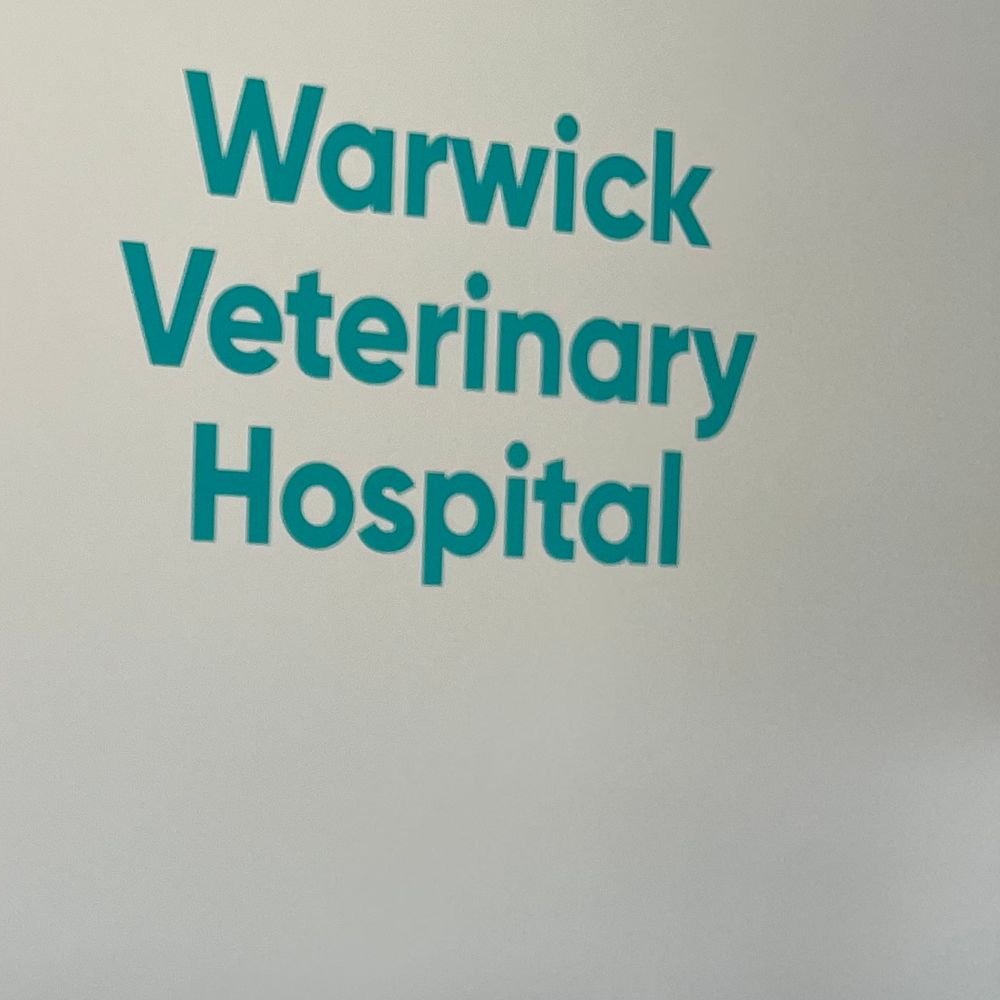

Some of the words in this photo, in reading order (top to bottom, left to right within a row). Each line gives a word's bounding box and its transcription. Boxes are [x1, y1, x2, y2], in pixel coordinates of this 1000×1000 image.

[185, 70, 713, 248] Warwick
[121, 240, 756, 440] Veterinary
[192, 422, 683, 587] Hospital
